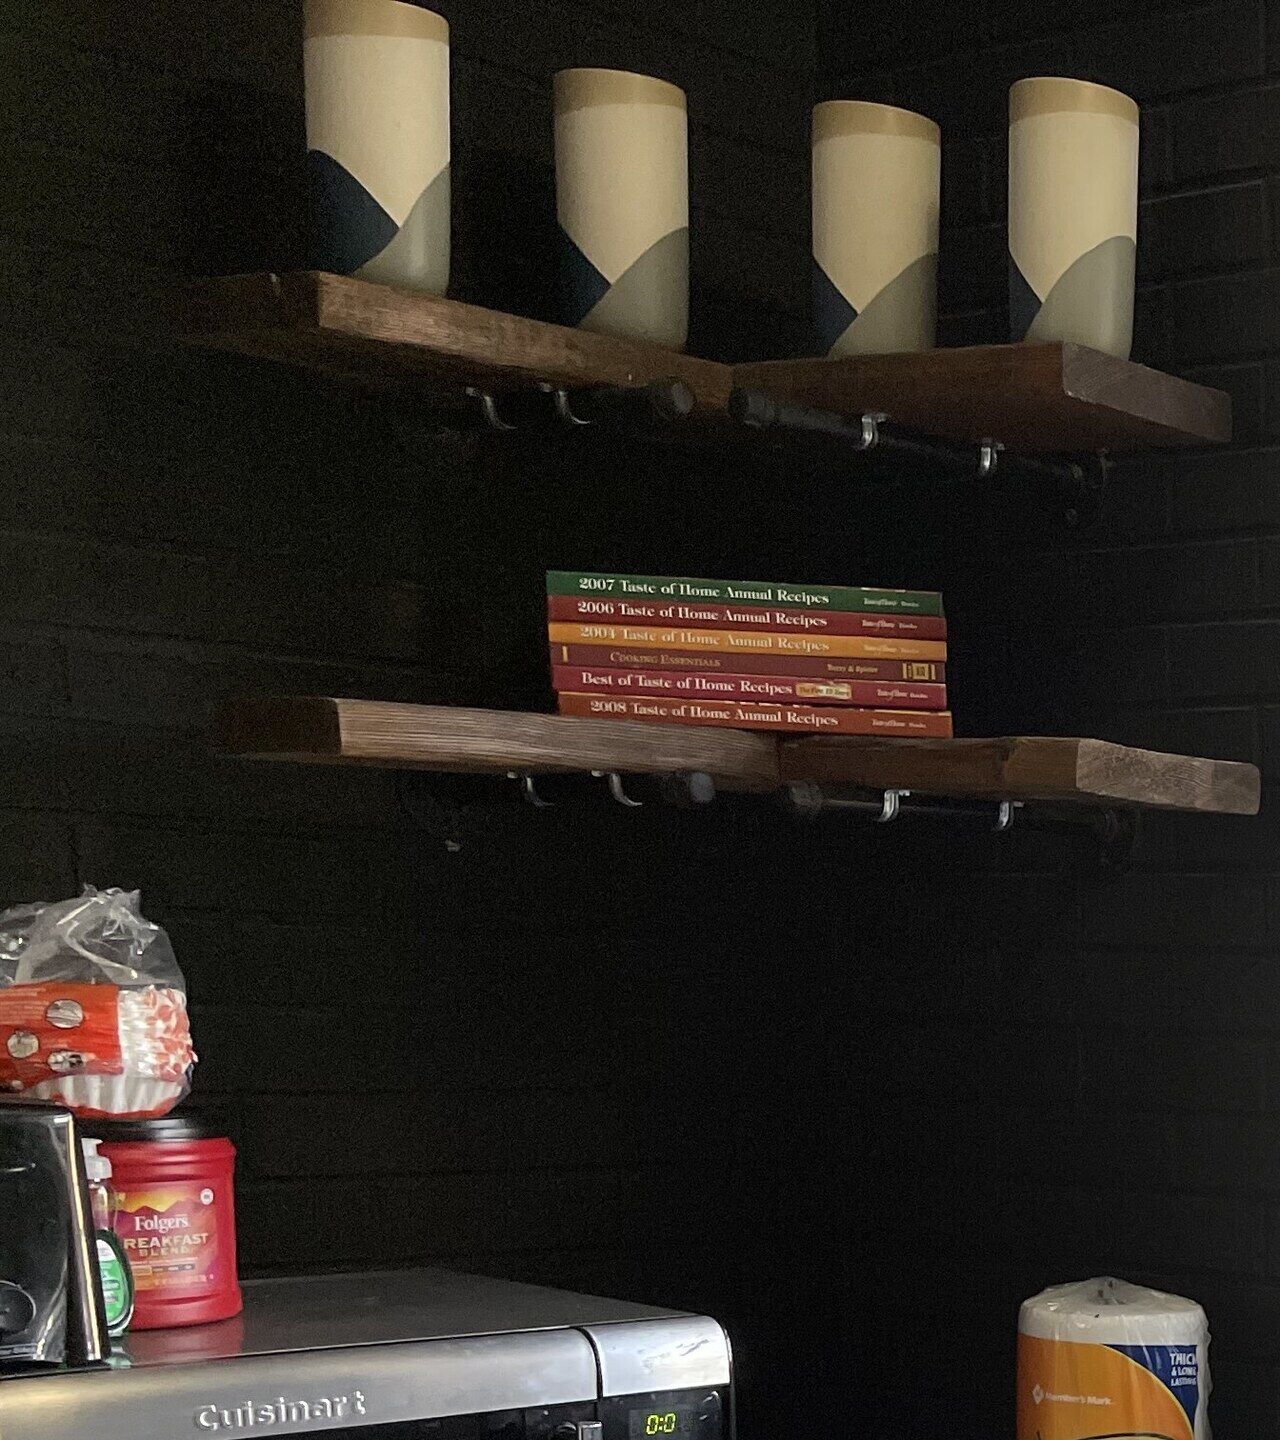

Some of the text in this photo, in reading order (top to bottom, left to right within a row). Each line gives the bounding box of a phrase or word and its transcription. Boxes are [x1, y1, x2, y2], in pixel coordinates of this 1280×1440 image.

[579, 578, 830, 605] 2007 Taste of Home Annual Recipes
[578, 601, 828, 628] 2006 Taste of Home Annual Recipes
[581, 626, 830, 652] 2004 Taste of Home Annual Recipes
[582, 672, 792, 695] Best of Taste of Home Recipes
[591, 701, 839, 727] 2008 Taste of Home Annual Recipes
[134, 1214, 189, 1234] Folgers
[124, 1233, 208, 1249] REAKFAST
[195, 1390, 366, 1430] Cuisinart
[645, 1413, 676, 1435] 0:0
